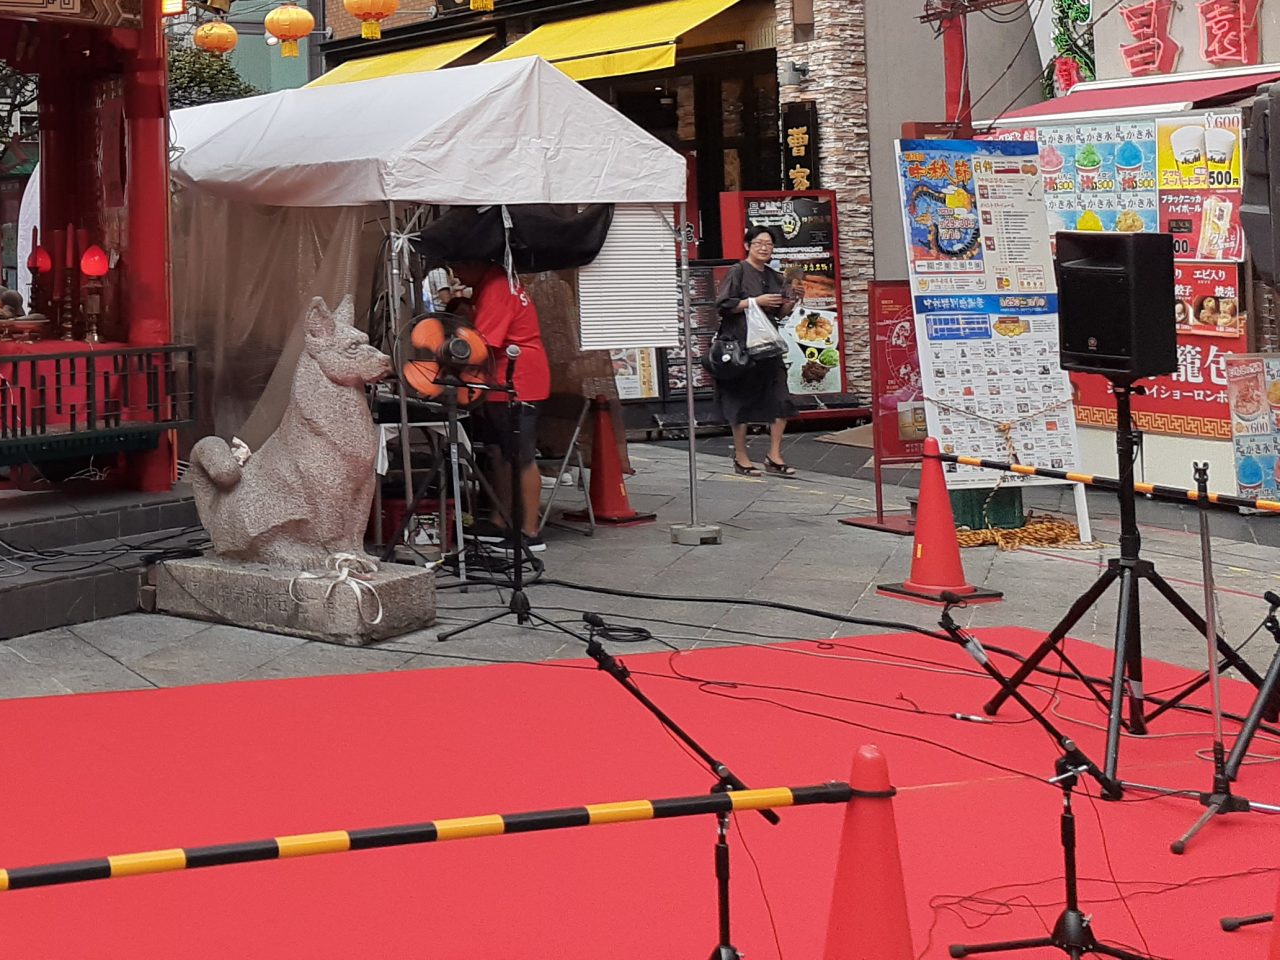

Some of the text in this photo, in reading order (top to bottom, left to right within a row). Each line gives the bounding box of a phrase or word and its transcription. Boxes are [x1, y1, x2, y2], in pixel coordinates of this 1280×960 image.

[1087, 132, 1113, 142] かき氷
[1126, 129, 1153, 140] かき氷
[1087, 199, 1114, 209] かき氷
[1127, 198, 1154, 208] かき氷
[1161, 194, 1201, 204] ブラックニッカ
[1048, 200, 1074, 209] かき氷
[1168, 204, 1201, 213] ハイボール
[1192, 268, 1226, 281] エビ入り
